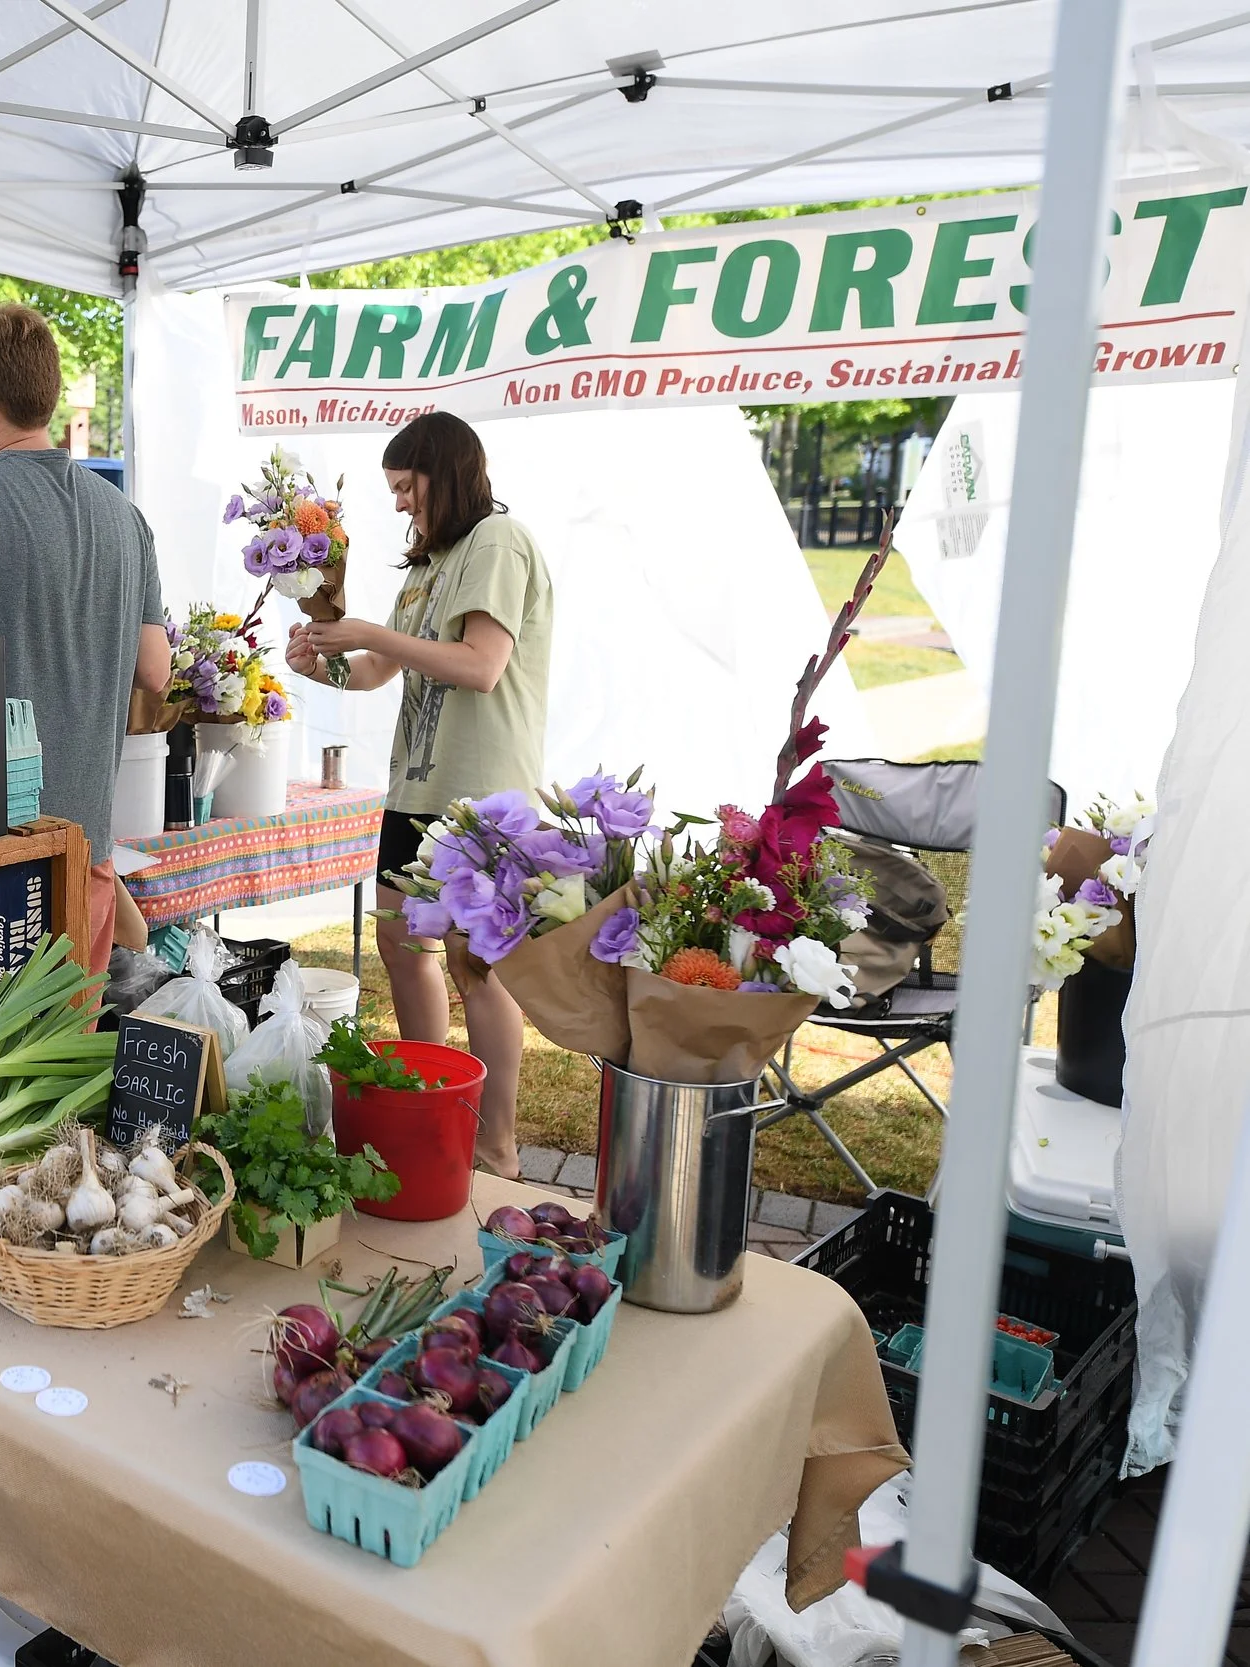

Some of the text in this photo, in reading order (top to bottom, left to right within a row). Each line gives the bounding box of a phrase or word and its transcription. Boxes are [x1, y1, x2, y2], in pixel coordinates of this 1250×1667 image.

[242, 288, 508, 382] FARM
[525, 264, 597, 357] &
[503, 340, 1227, 407] Non GMO Produce, Sustainab Grown
[241, 402, 308, 429] Mason,
[26, 876, 42, 951] SUNNY
[9, 919, 26, 977] BRA
[123, 1026, 187, 1070] Fresh
[114, 1064, 186, 1105] GARLIC
[110, 1125, 127, 1143] No
[112, 1103, 128, 1121] No
